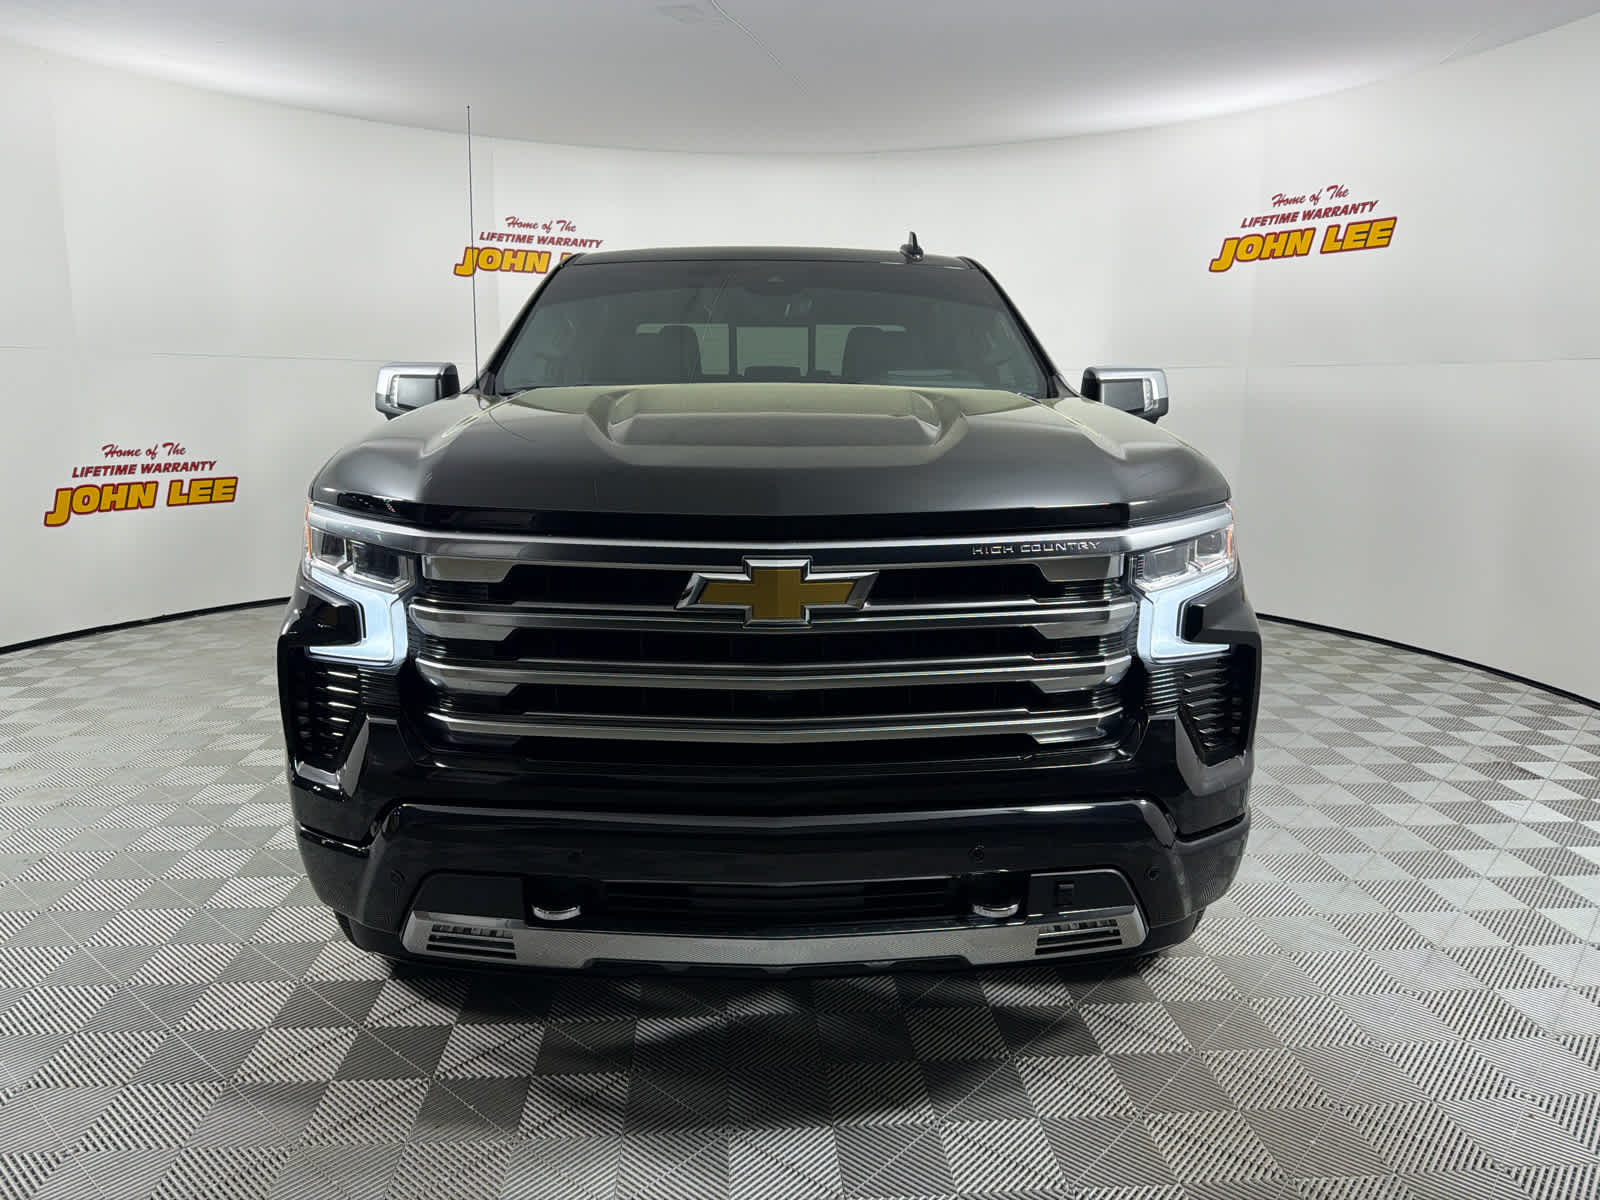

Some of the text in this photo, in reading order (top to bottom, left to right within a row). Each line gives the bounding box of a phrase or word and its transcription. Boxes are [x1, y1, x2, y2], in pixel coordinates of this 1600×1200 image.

[1271, 184, 1350, 208] Home of The
[505, 215, 576, 233] Home of The
[1240, 200, 1379, 229] LIFETIME WARRANTY
[479, 231, 603, 249] LIFETIME WARRANTY
[1208, 216, 1397, 273] JOHN LEE
[454, 246, 551, 277] JOHN
[101, 442, 187, 459] Home of The
[72, 460, 217, 478] LIFETIME WARRANTY
[44, 476, 238, 527] JOHN LEE
[972, 541, 1100, 555] HIGH COUNTRY
